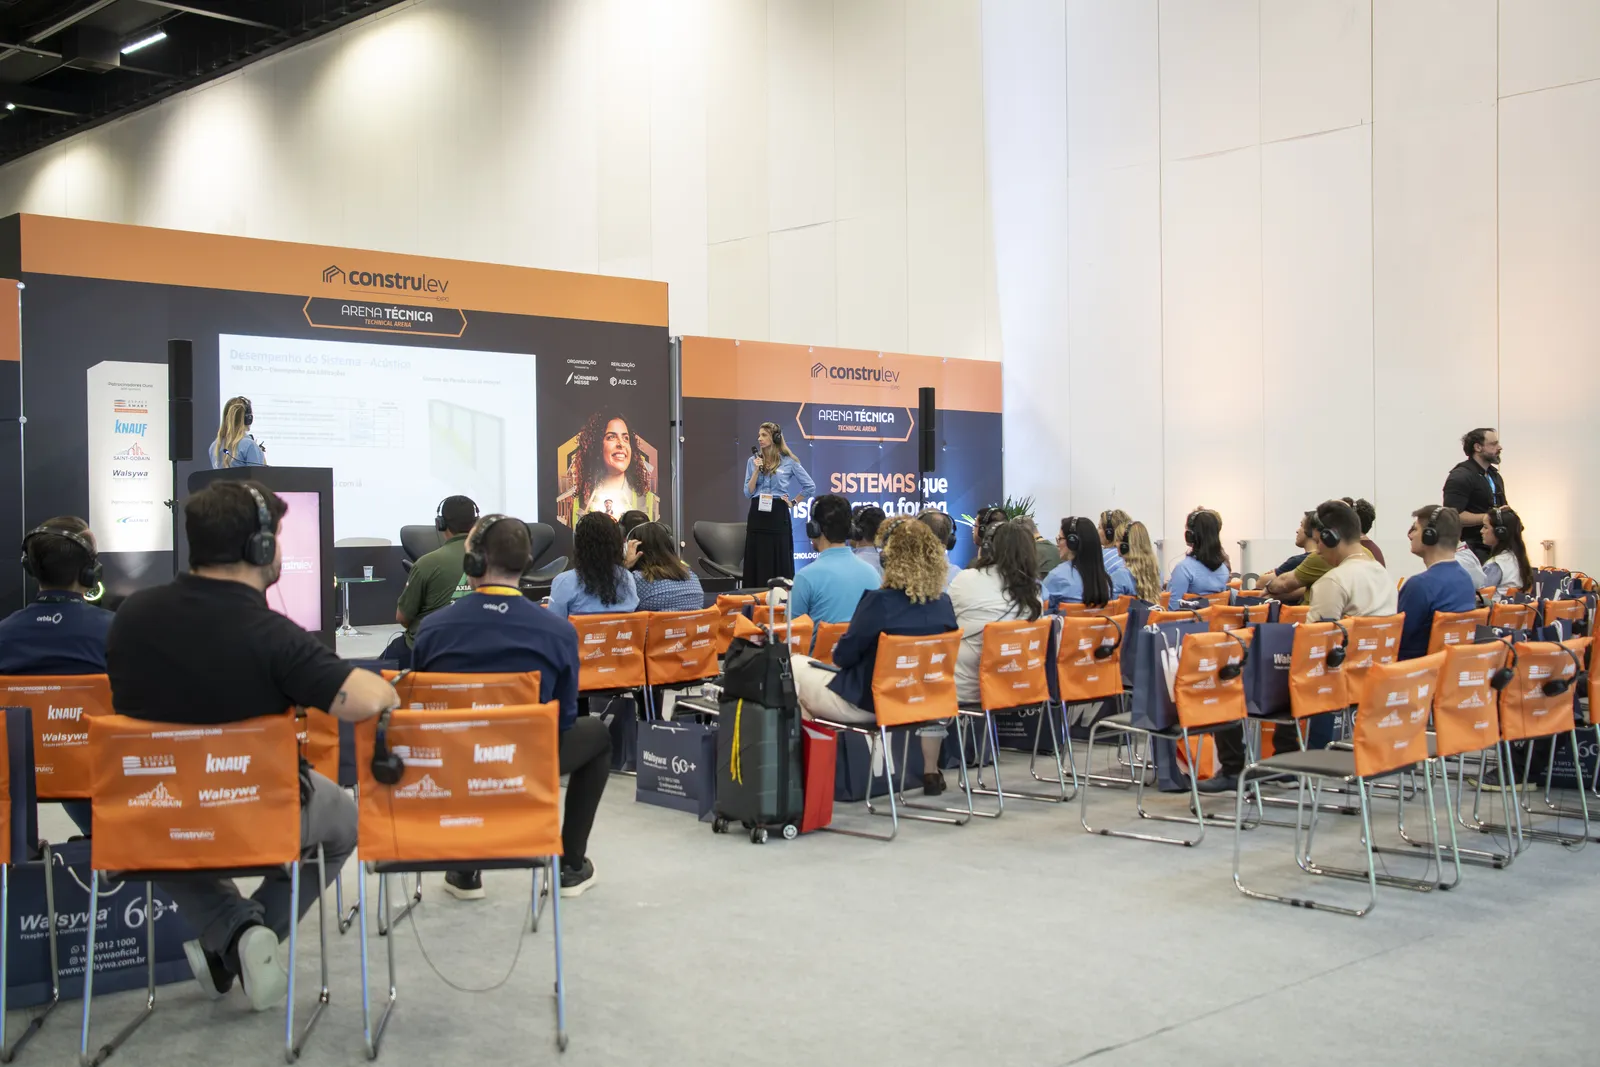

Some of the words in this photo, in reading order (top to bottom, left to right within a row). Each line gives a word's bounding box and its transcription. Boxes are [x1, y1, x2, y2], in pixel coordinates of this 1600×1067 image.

[349, 270, 449, 293] construlev
[341, 304, 382, 318] ARENA
[384, 306, 433, 322] TÉCNICA
[365, 319, 393, 327] TECHNICAL
[394, 320, 411, 328] ARENA
[229, 349, 302, 364] Desempenho
[304, 353, 318, 364] do
[321, 353, 361, 367] Sistema
[829, 366, 900, 382] construlev
[818, 409, 853, 422] ARENA
[854, 408, 895, 423] TÉCNICA
[114, 419, 148, 437] KNAUF
[838, 424, 861, 432] TECHNICAL
[112, 469, 149, 479] Walsywa
[830, 472, 916, 493] SISTEMAS
[918, 476, 948, 497] que
[281, 560, 313, 570] nstrulev
[47, 705, 83, 722] KNAUF
[42, 732, 88, 744] Walsywa
[473, 744, 516, 764] KNAUF
[643, 750, 667, 765] Walsywa
[206, 753, 251, 774] KNAUF
[468, 776, 524, 790] Walsywa
[199, 785, 257, 802] Walsywa
[128, 799, 182, 808] SAINT-GOBAIN
[116, 937, 136, 947] 1000
[80, 947, 140, 963] wsywaoficial
